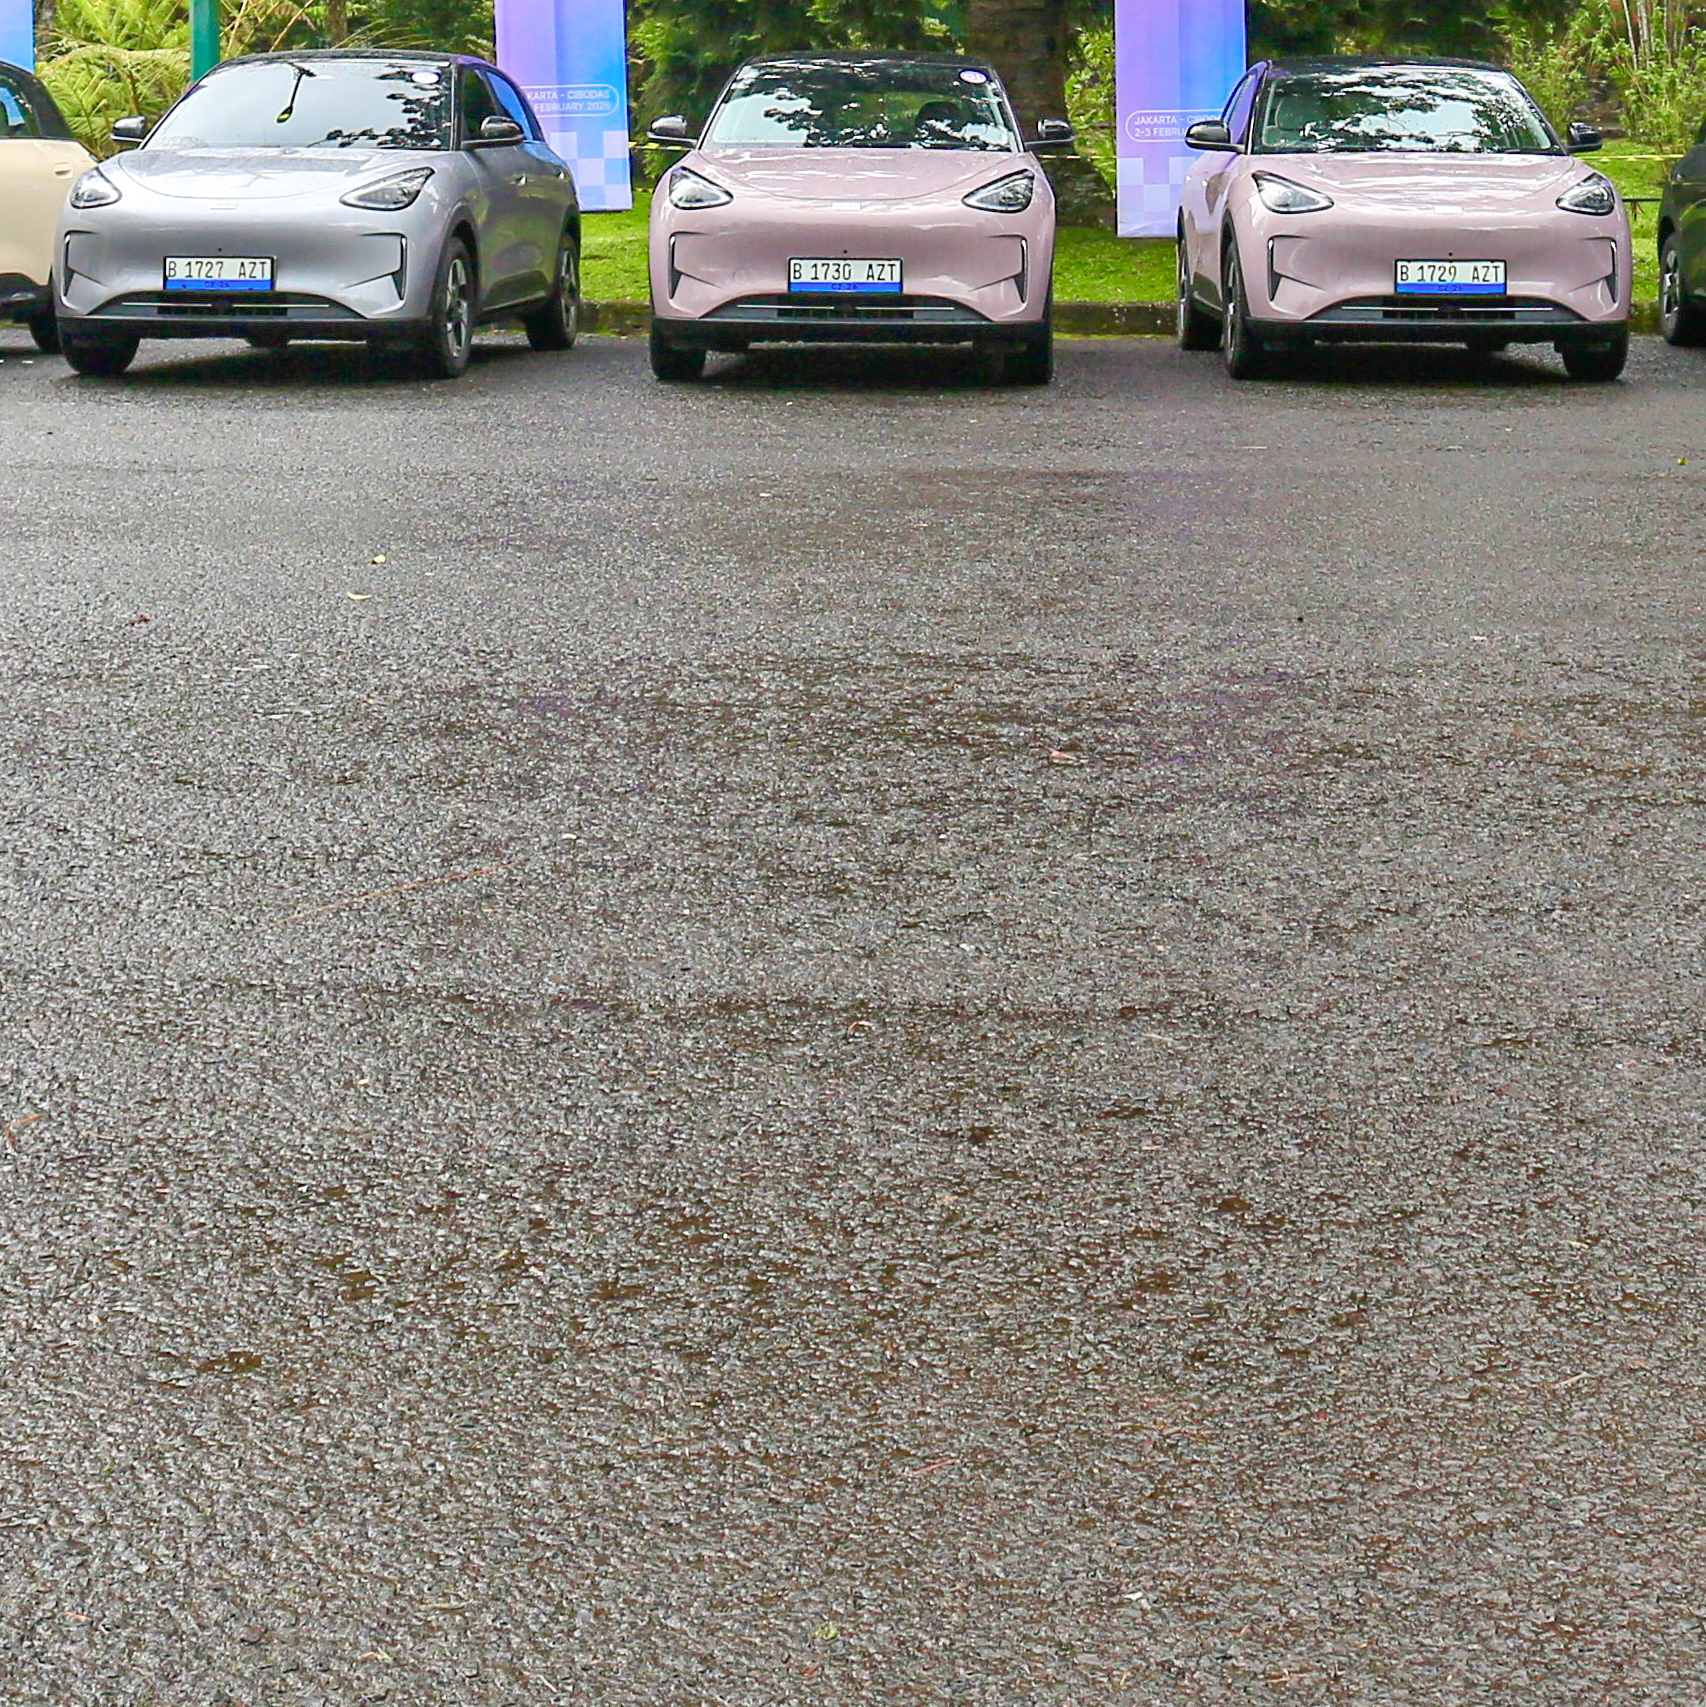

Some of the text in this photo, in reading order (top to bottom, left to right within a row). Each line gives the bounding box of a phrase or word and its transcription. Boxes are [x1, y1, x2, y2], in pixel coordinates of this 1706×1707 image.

[567, 90, 610, 99] CIBODAS
[534, 102, 584, 112] FEBRUARY
[1134, 115, 1177, 125] JAKARTA
[1134, 127, 1187, 137] 2-3 FEBRU
[168, 261, 267, 279] B 1727 AZT
[793, 262, 896, 281] B 1730 AZT
[1400, 264, 1500, 282] B 1729 AZT
